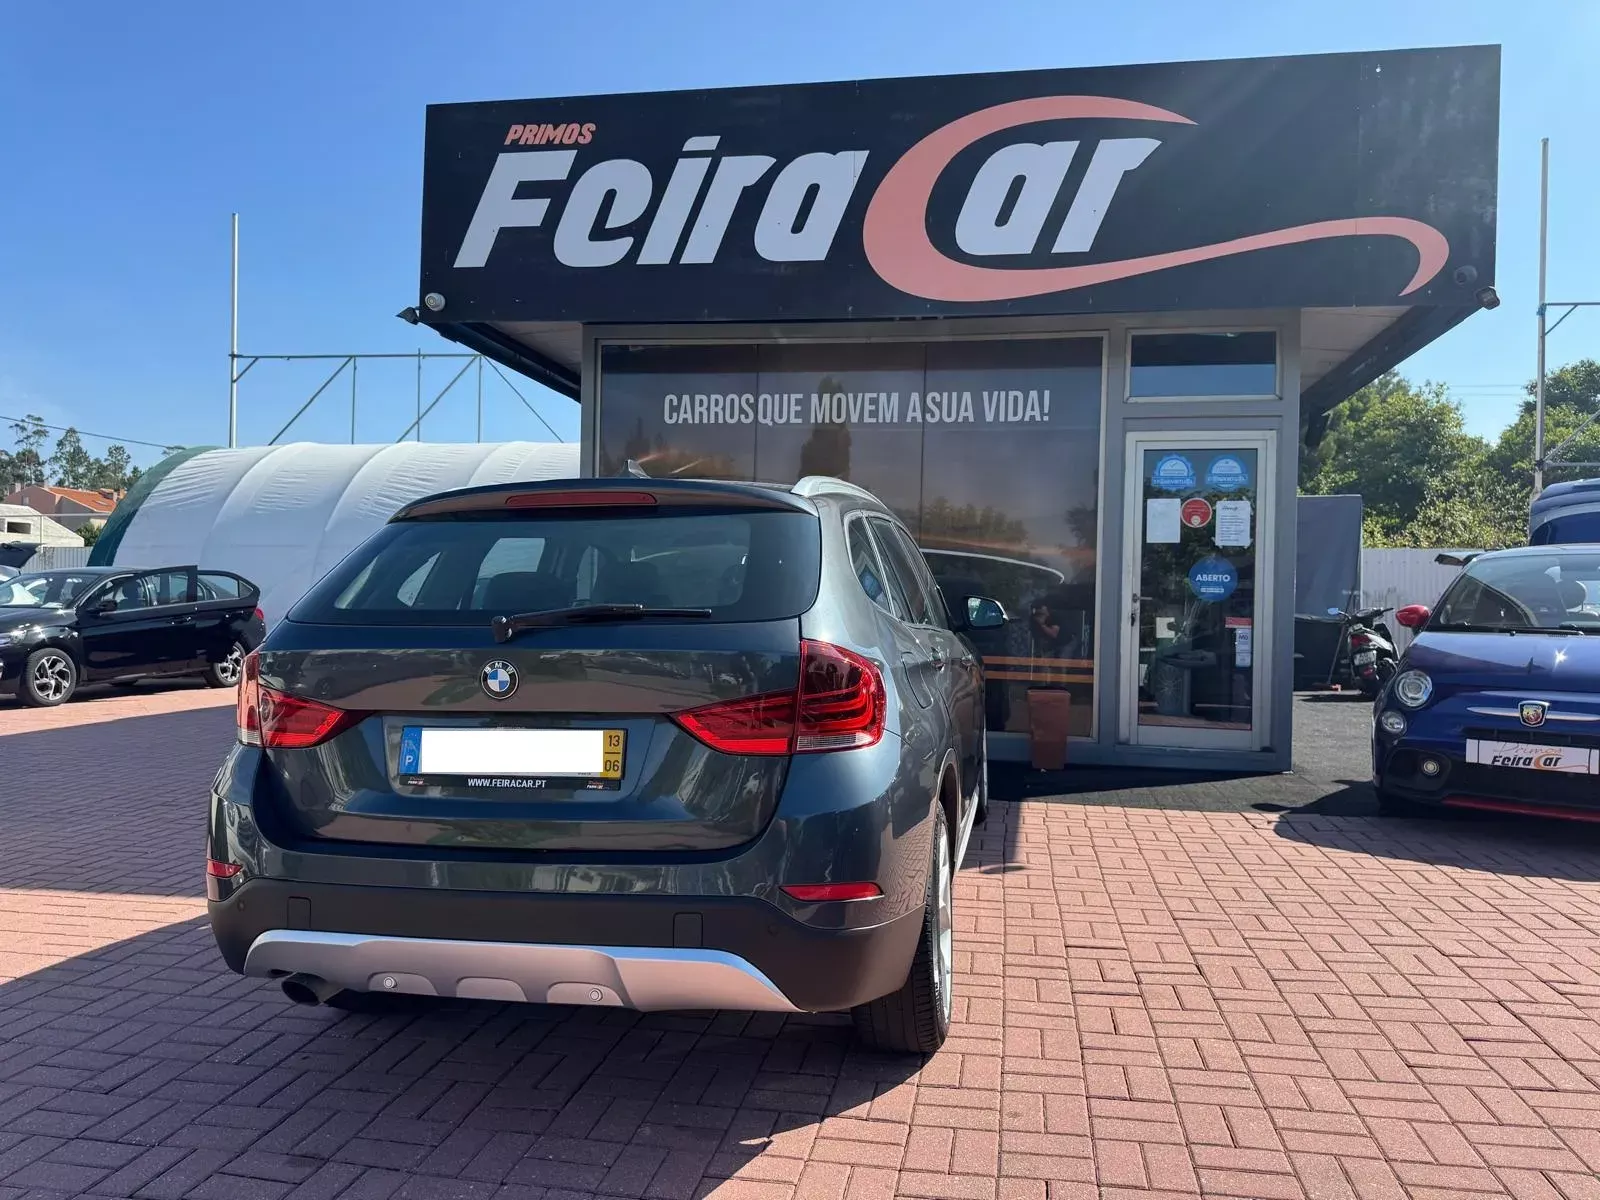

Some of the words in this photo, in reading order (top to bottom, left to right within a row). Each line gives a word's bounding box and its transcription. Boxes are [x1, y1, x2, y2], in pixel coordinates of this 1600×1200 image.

[503, 123, 596, 145] PRIMOS
[453, 95, 1198, 302] FeiraCar
[663, 393, 754, 425] CARROS
[758, 393, 803, 426] QUE
[810, 392, 899, 424] MOVEM
[906, 392, 922, 423] A
[925, 391, 975, 423] SUA
[983, 390, 1050, 423] VIDA!
[1195, 574, 1231, 582] ABERTO
[608, 734, 620, 747] 13
[403, 754, 414, 766] P
[604, 759, 620, 772] 06
[1491, 752, 1563, 770] FeiraCar
[467, 777, 547, 789] WWW.FEIRACAR.PT
